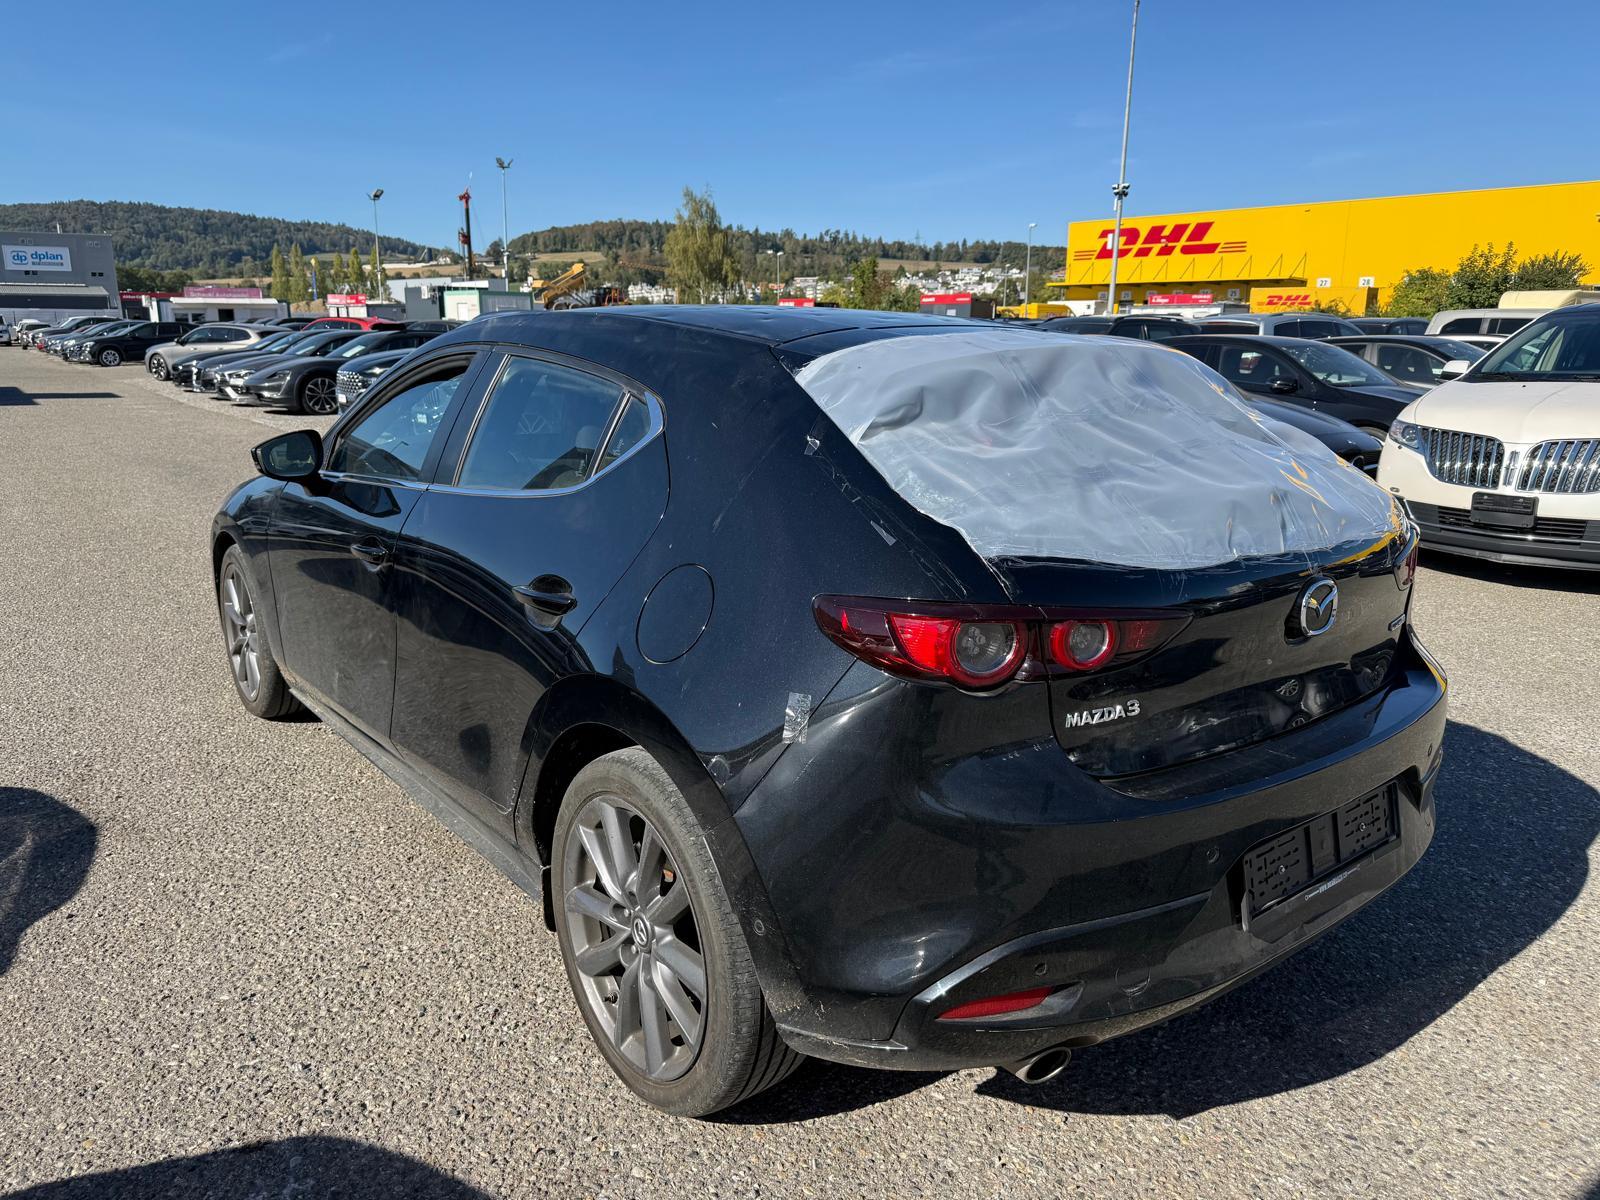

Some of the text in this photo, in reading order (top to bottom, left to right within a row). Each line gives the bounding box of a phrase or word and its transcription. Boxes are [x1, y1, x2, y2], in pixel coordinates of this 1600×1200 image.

[1095, 222, 1221, 259] DHL
[31, 251, 63, 262] dplan
[1266, 295, 1312, 306] DHL
